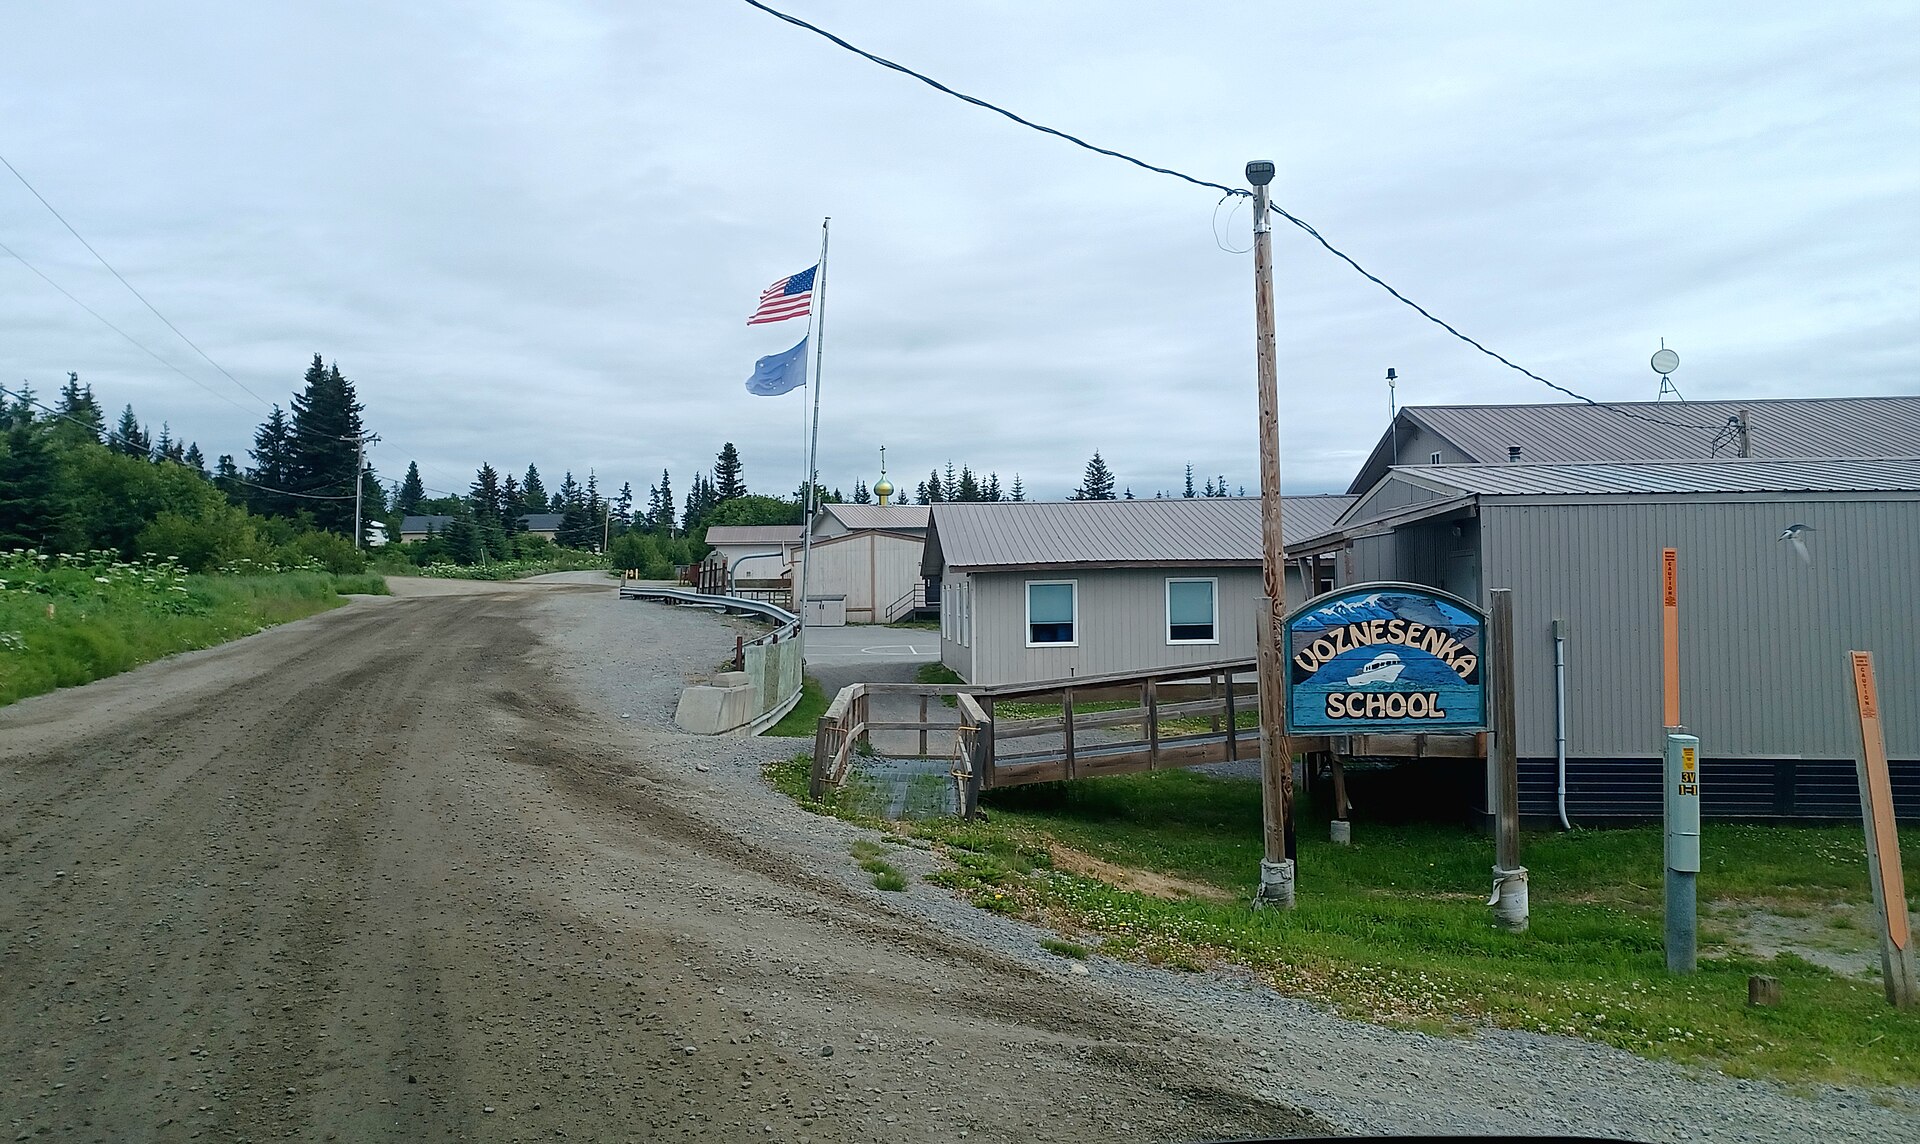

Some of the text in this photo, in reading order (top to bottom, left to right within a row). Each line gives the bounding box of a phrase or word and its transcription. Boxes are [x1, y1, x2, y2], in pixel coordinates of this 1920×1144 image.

[1294, 619, 1477, 678] VOZNESENKA
[1860, 667, 1870, 706] CAUTION
[1327, 692, 1446, 719] SCHOOL
[1682, 772, 1695, 783] 3V
